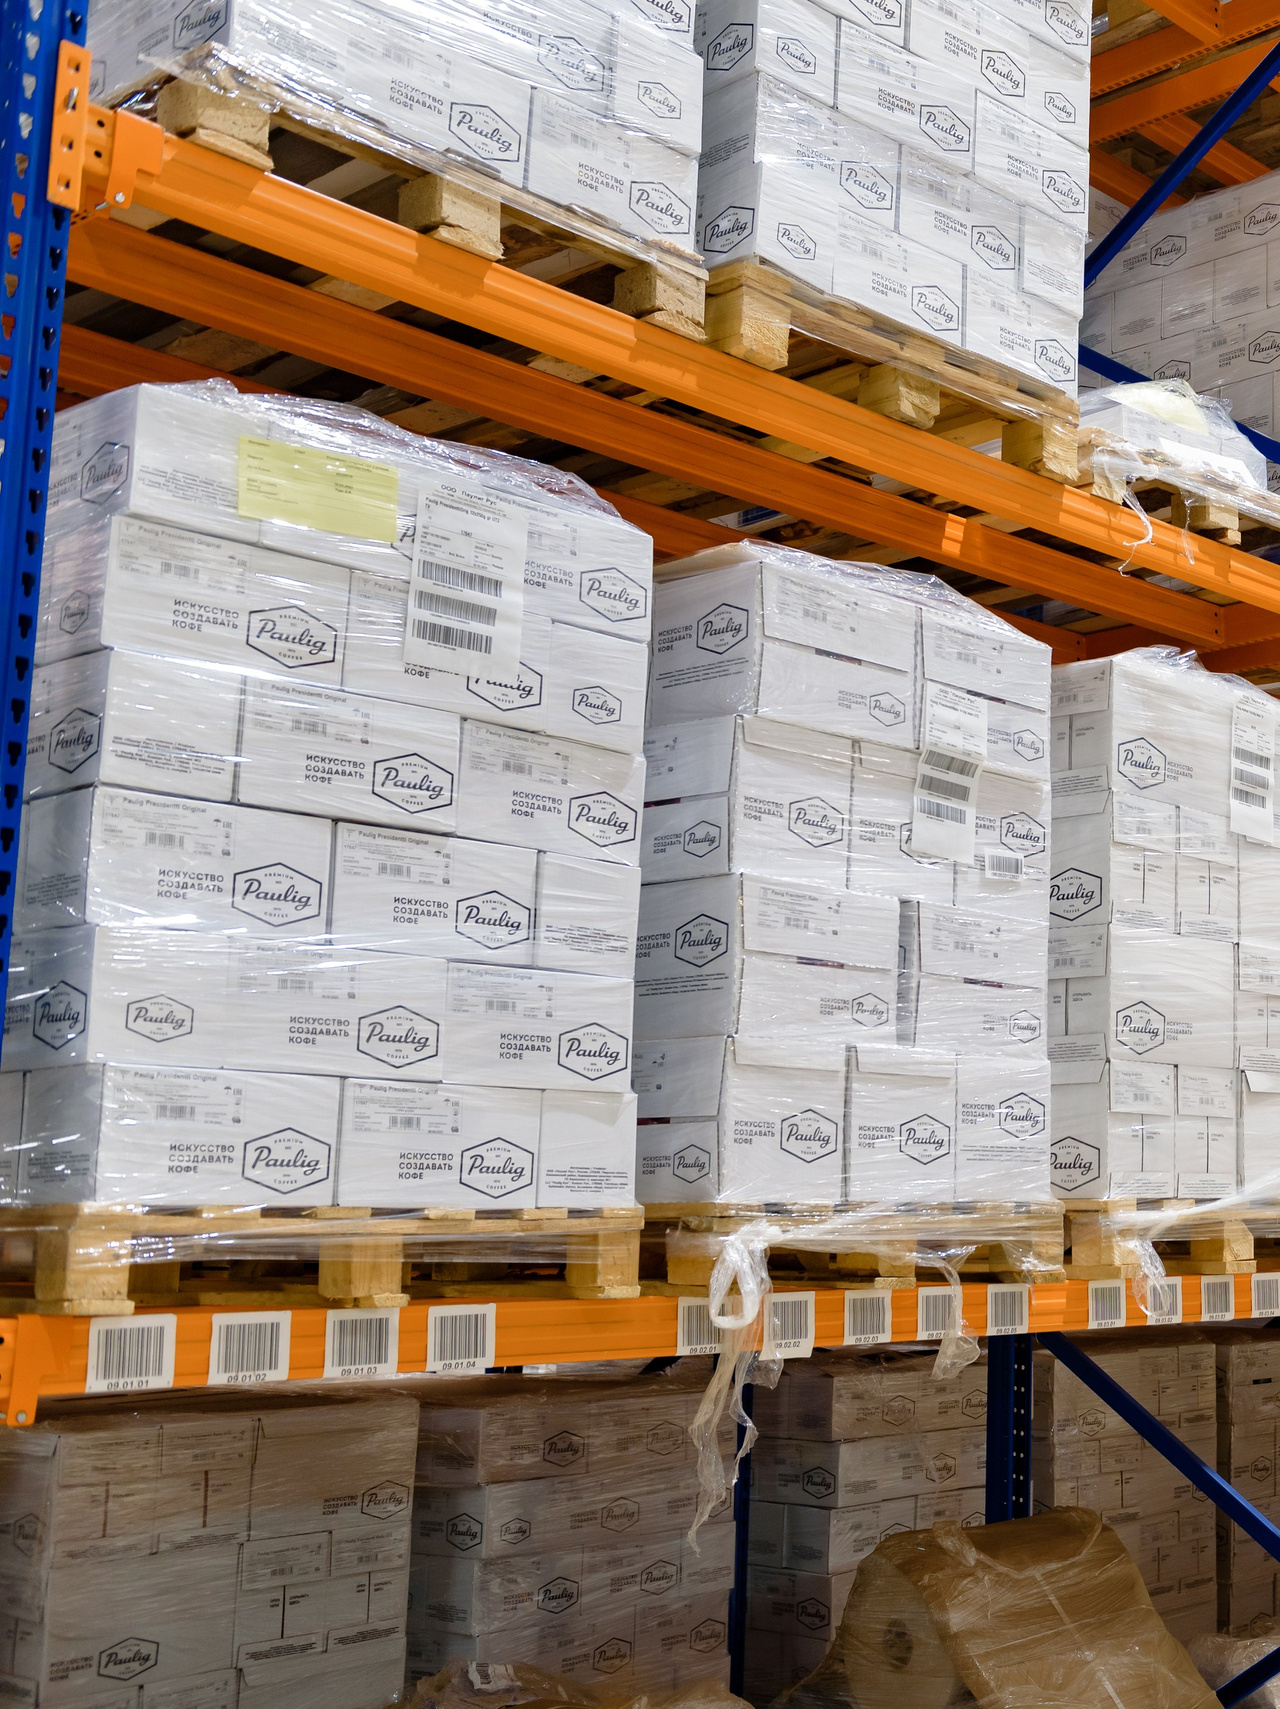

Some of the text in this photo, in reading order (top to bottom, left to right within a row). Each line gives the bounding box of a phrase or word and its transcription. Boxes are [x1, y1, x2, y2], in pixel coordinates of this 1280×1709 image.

[179, 8, 221, 38] Paulig
[1049, 8, 1084, 39] Paulig
[711, 36, 748, 61] Paulig
[780, 44, 811, 68] Paulig
[985, 58, 1020, 89] Paulig
[391, 77, 444, 106] ИСКУССТВО
[389, 96, 414, 111] КОФЕ
[642, 88, 676, 112] Paulig
[1047, 98, 1072, 118] Paulig
[458, 111, 514, 152] Paulig
[924, 112, 964, 144] Paulig
[578, 162, 624, 186] ИСКУССТВО
[578, 171, 623, 194] СОЗДАВАТЬ
[578, 178, 599, 192] КОФЕ
[636, 189, 684, 226] Paulig
[1248, 212, 1277, 227] Paulig
[709, 219, 749, 244] Paulig
[781, 232, 812, 254] Paulig
[975, 234, 1011, 262] Paulig
[1154, 244, 1182, 259] Paulig
[916, 293, 954, 321] Paulig
[1038, 346, 1071, 374] Paulig
[84, 459, 124, 490] Paulig
[524, 578, 546, 589] КОФЕ
[525, 570, 573, 587] СОЗДАВАТЬ
[587, 578, 640, 610] Paulig
[174, 599, 240, 619] ИСКУССТВО
[172, 620, 202, 632] КОФЕ
[173, 609, 238, 630] СОЗДАВАТЬ
[702, 615, 743, 639] Paulig
[256, 618, 327, 655] Paulig
[658, 633, 692, 644] СОЗДАВАТЬ
[659, 625, 692, 636] ИСКУССТВО
[658, 644, 674, 653] КОФЕ
[404, 667, 430, 679] КОФЕ
[576, 693, 616, 716] Paulig
[874, 700, 901, 718] Paulig
[54, 726, 94, 754] Paulig
[306, 754, 366, 770] ИСКУССТВО
[401, 762, 428, 770] PREMIUM
[1124, 749, 1161, 777] Paulig
[304, 774, 332, 784] КОФЕ
[305, 764, 364, 779] СОЗДАВАТЬ
[380, 767, 445, 800] Paulig
[401, 798, 424, 806] COFFEE
[512, 790, 563, 806] ИСКУССТВО
[744, 796, 784, 809] ИСКУССТВО
[511, 808, 535, 818] КОФЕ
[512, 800, 562, 815] СОЗДАВАТЬ
[744, 805, 783, 818] СОЗДАВАТЬ
[575, 804, 629, 833] Paulig
[744, 813, 761, 821] КОФЕ
[794, 805, 838, 833] Paulig
[359, 830, 429, 846] Paulig Presidentti Original
[688, 831, 716, 848] Paulig
[1005, 825, 1041, 843] Paulig
[158, 869, 224, 883] ИСКУССТВО
[264, 872, 294, 880] PREMIUM
[158, 879, 224, 894] СОЗДАВАТЬ
[242, 878, 312, 911] Paulig
[1050, 884, 1095, 904] Paulig
[157, 890, 188, 900] КОФЕ
[394, 897, 449, 909] ИСКУССТВО
[393, 907, 449, 919] СОЗДАВАТЬ
[393, 916, 418, 925] КОФЕ
[463, 905, 522, 934] Paulig
[682, 926, 722, 951] Paulig
[39, 1002, 80, 1030] Paulig
[134, 1006, 186, 1030] Paulig
[856, 1002, 884, 1018] Paulig
[289, 1016, 349, 1027] ИСКУССТВО
[1122, 1015, 1160, 1040] Paulig
[289, 1026, 349, 1036] СОЗДАВАТЬ
[366, 1022, 430, 1051] Paulig
[500, 1033, 552, 1043] ИСКУССТВО
[289, 1036, 317, 1045] КОФЕ
[500, 1043, 551, 1053] СОЗДАВАТЬ
[500, 1052, 523, 1060] КОФЕ
[566, 1038, 620, 1065] Paulig
[734, 1120, 775, 1129] ИСКУССТВО
[1004, 1107, 1040, 1126] Paulig
[734, 1137, 753, 1145] КОФЕ
[786, 1125, 832, 1148] Paulig
[905, 1128, 946, 1150] Paulig
[169, 1144, 235, 1153] ИСКУССТВО
[400, 1152, 453, 1161] ИСКУССТВО
[169, 1154, 234, 1163] СОЗДАВАТЬ
[252, 1146, 321, 1176] Paulig
[399, 1162, 453, 1171] СОЗДАВАТЬ
[677, 1156, 707, 1173] Paulig
[168, 1165, 198, 1173] КОФЕ
[399, 1172, 423, 1180] КОФЕ
[468, 1154, 526, 1182] Paulig
[690, 1346, 717, 1354] 09.02.01
[775, 1341, 801, 1349] 09.02.02
[341, 1366, 378, 1377] 09.01.03
[442, 1360, 476, 1371] 09.01.04
[107, 1379, 150, 1390] 09.01.01
[227, 1373, 267, 1384] 09.01.02
[548, 1443, 579, 1455] Paulig
[804, 1475, 831, 1491] Paulig
[366, 1494, 404, 1508] Paulig
[451, 1525, 477, 1538] Paulig
[542, 1590, 574, 1602] Paulig
[800, 1607, 827, 1622] Paulig
[105, 1650, 152, 1666] Paulig
[598, 1649, 627, 1661] Paulig
